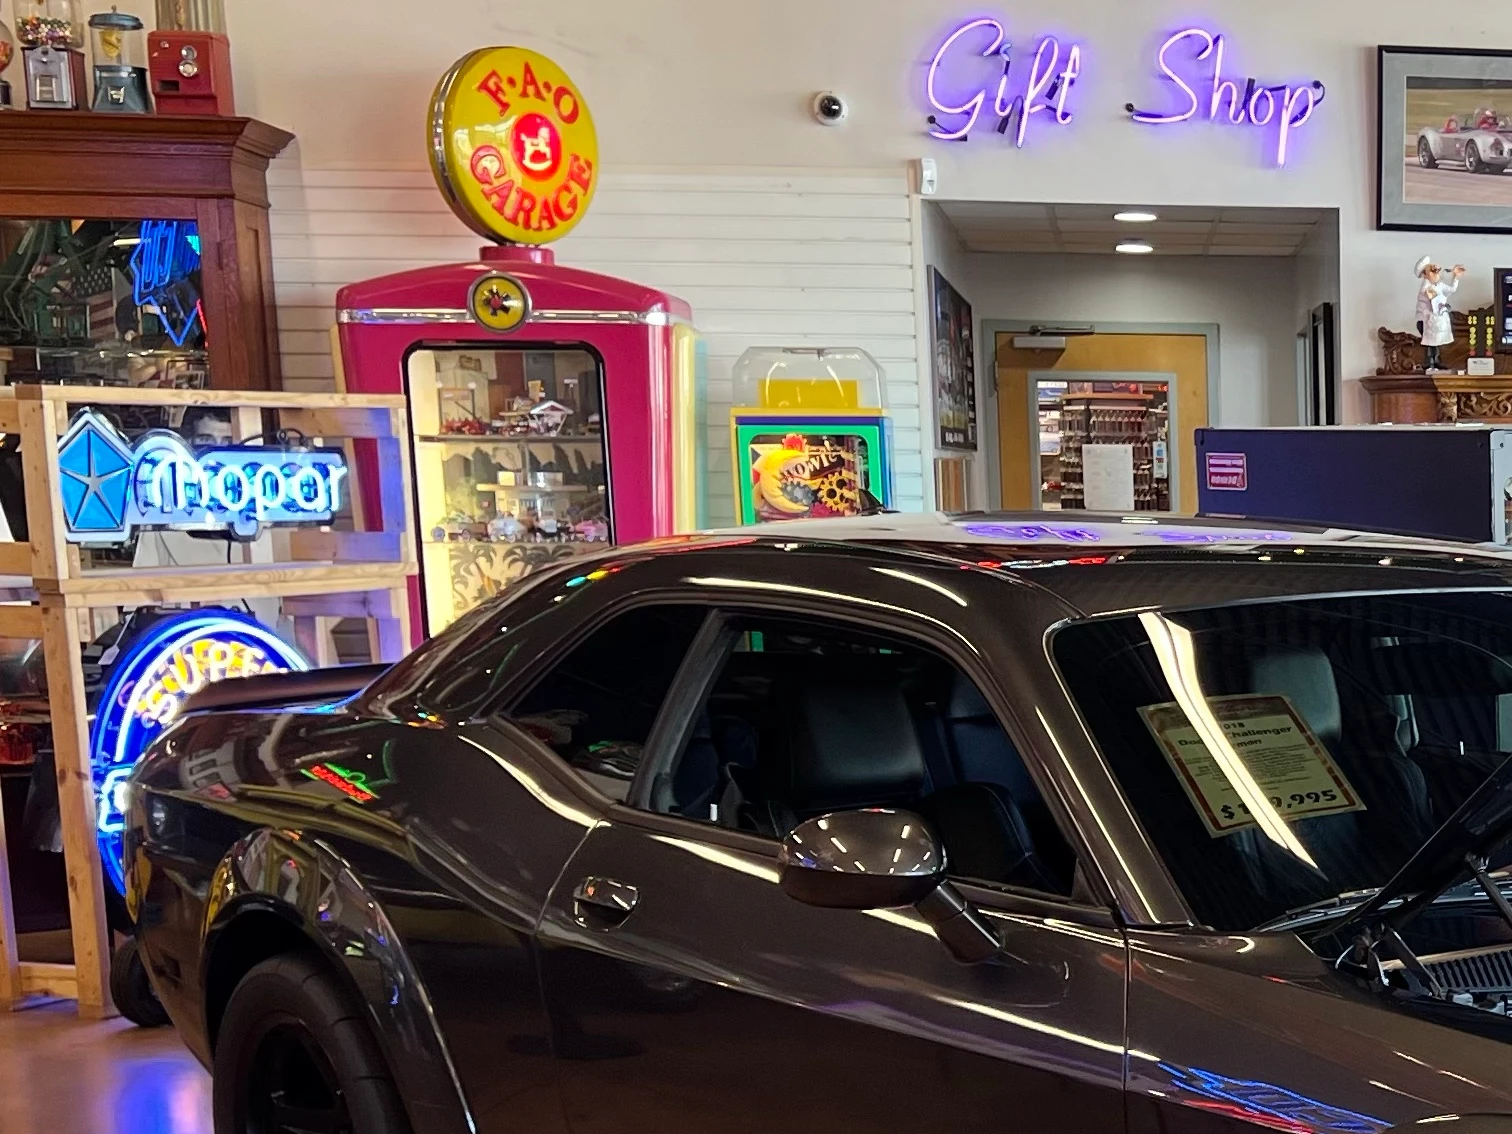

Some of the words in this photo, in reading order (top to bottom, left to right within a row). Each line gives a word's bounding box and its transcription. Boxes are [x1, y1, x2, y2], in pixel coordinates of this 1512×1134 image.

[926, 18, 1081, 148] Gift
[1131, 28, 1318, 168] Shop
[470, 144, 594, 232] GARAGE
[1235, 738, 1263, 748] mon
